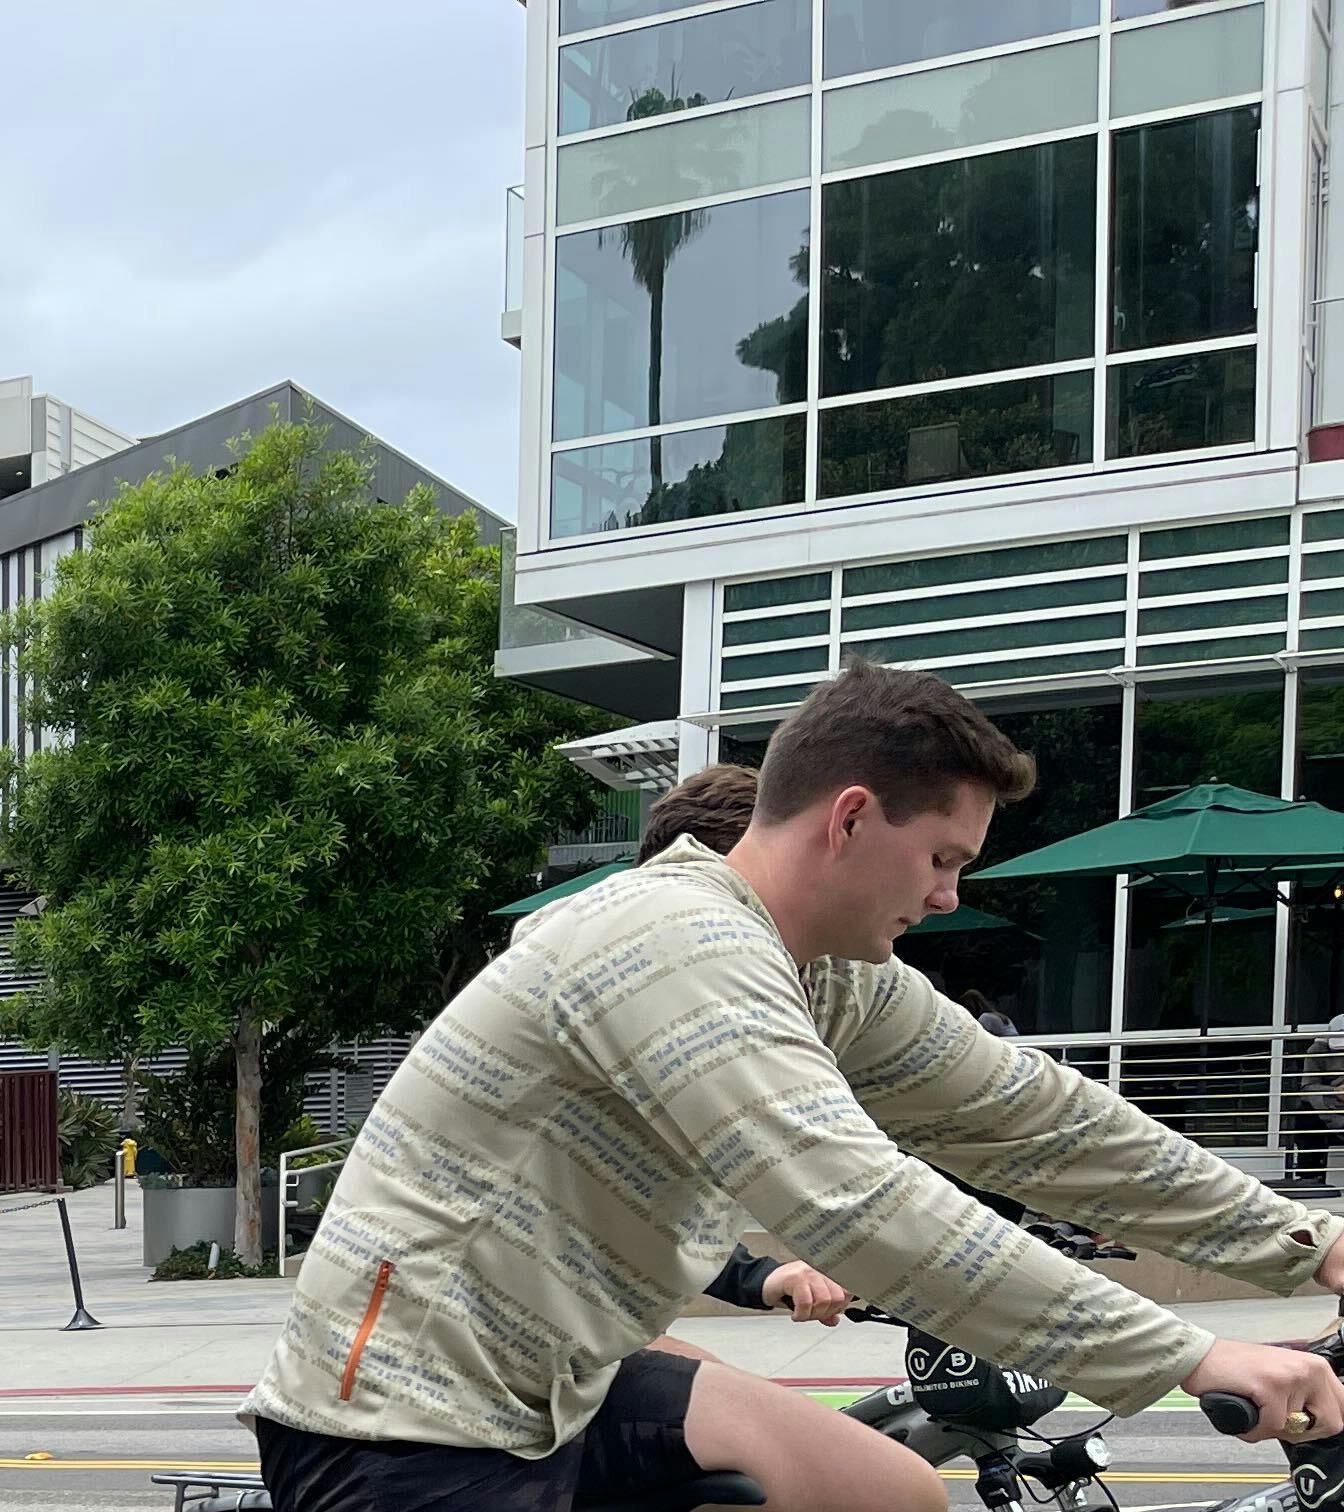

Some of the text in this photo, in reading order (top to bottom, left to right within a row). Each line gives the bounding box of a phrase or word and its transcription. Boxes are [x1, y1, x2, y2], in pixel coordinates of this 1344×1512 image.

[913, 1353, 967, 1371] U B
[949, 1378, 980, 1389] BIKING
[1300, 1476, 1315, 1496] U
